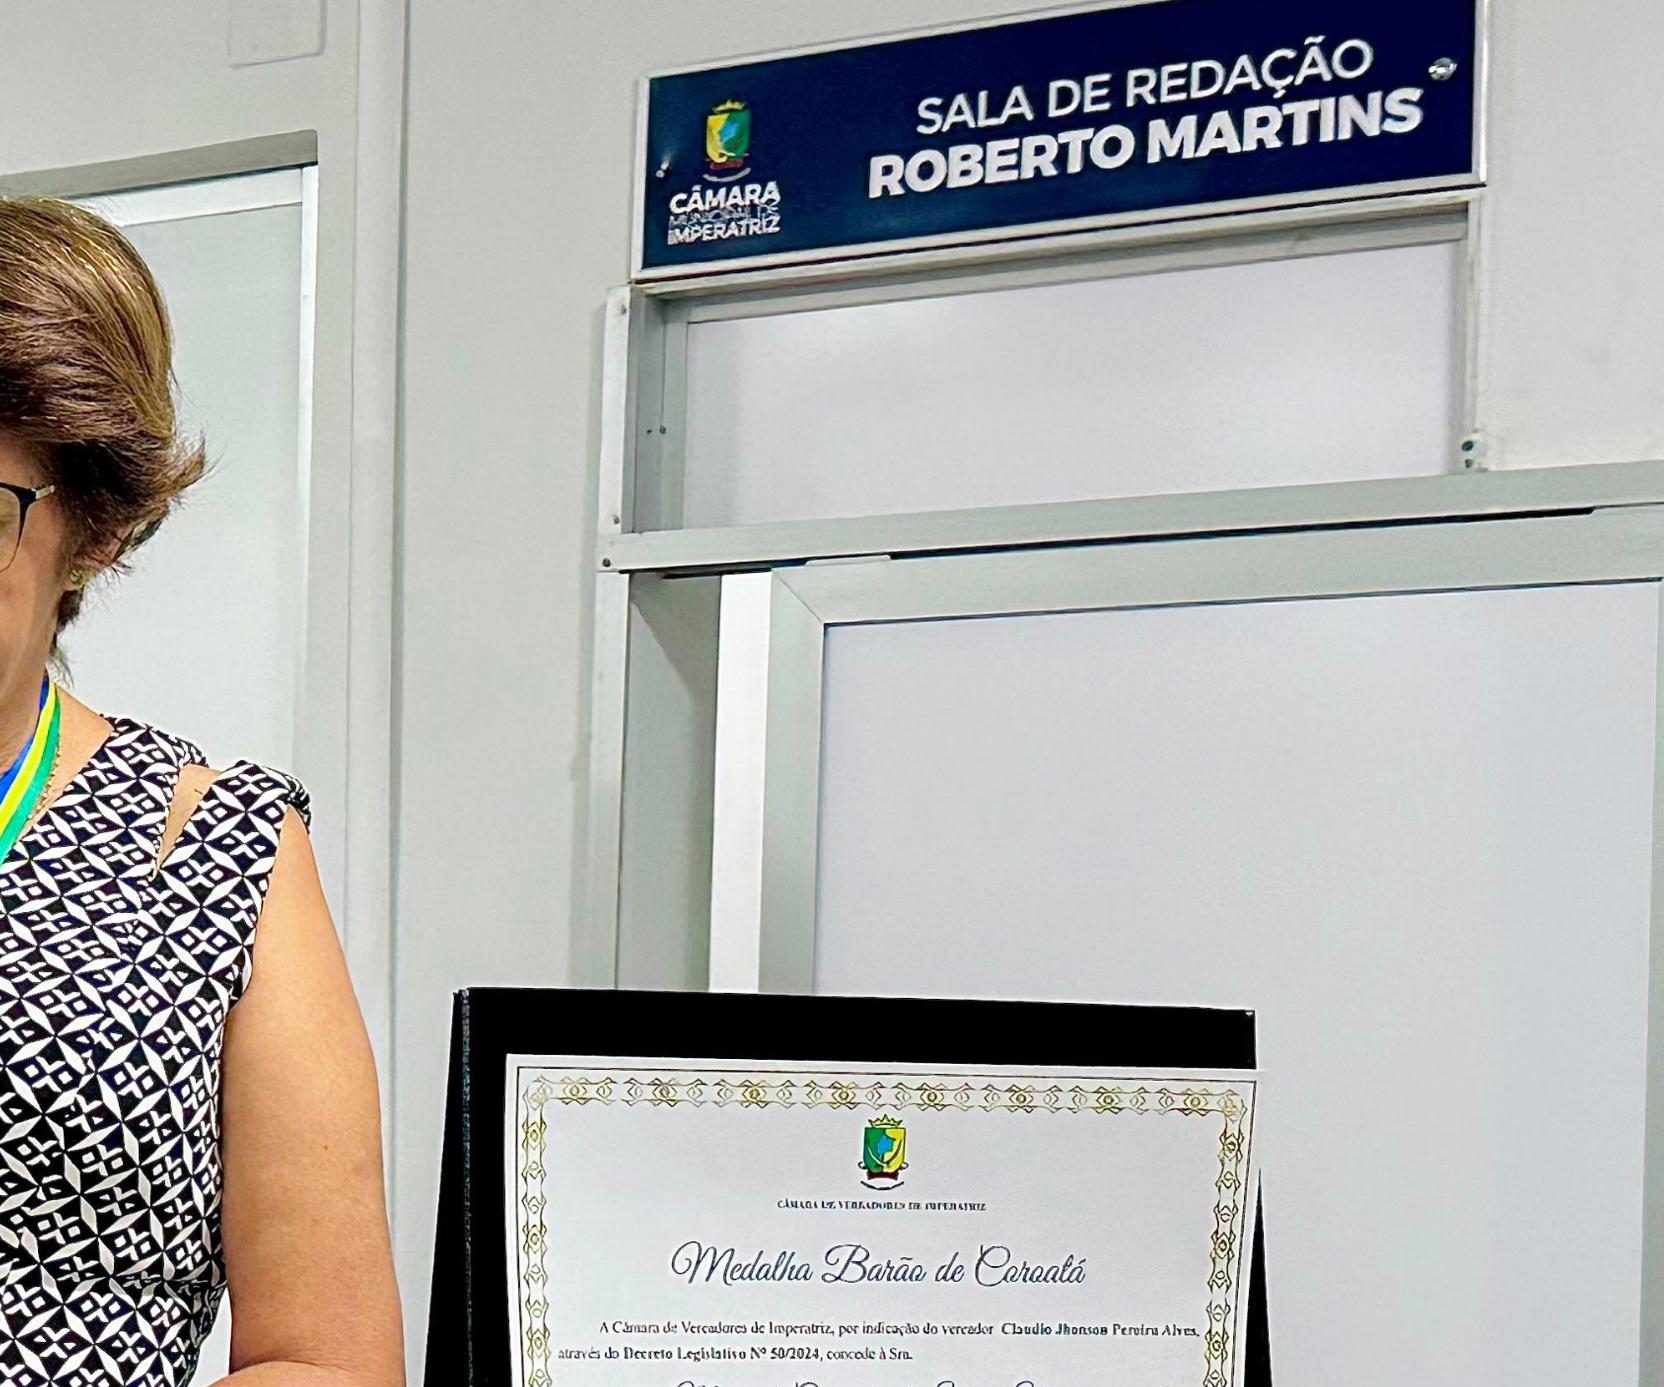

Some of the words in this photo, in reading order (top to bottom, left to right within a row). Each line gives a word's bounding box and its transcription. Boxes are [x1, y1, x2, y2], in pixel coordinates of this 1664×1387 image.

[916, 84, 1034, 135] SALA
[1047, 73, 1112, 118] DE
[1125, 34, 1374, 108] REDAÇÃO
[868, 123, 1136, 199] ROBERTO
[1146, 87, 1424, 164] MARTINS
[669, 181, 781, 214] CÂMARA
[667, 215, 781, 245] IMPERATRIZ
[670, 1240, 814, 1286] Medalha
[821, 1244, 928, 1284] Barão
[934, 1251, 966, 1283] de
[974, 1244, 1088, 1287] Coroatá
[599, 1321, 609, 1334] A
[612, 1320, 660, 1334] Câmara
[663, 1321, 678, 1335] de
[681, 1321, 747, 1335] Vereadores
[751, 1321, 766, 1335] de
[769, 1322, 835, 1338] Imperatriz,
[838, 1324, 860, 1338] por
[862, 1322, 920, 1338] indicação
[923, 1322, 938, 1336] do
[942, 1322, 994, 1336] vereador
[1001, 1323, 1053, 1336] Claudio
[558, 1347, 602, 1360] através
[604, 1347, 620, 1360] do
[623, 1347, 674, 1360] Decreto
[677, 1347, 746, 1362] Legislativo
[827, 1347, 876, 1361] concede
